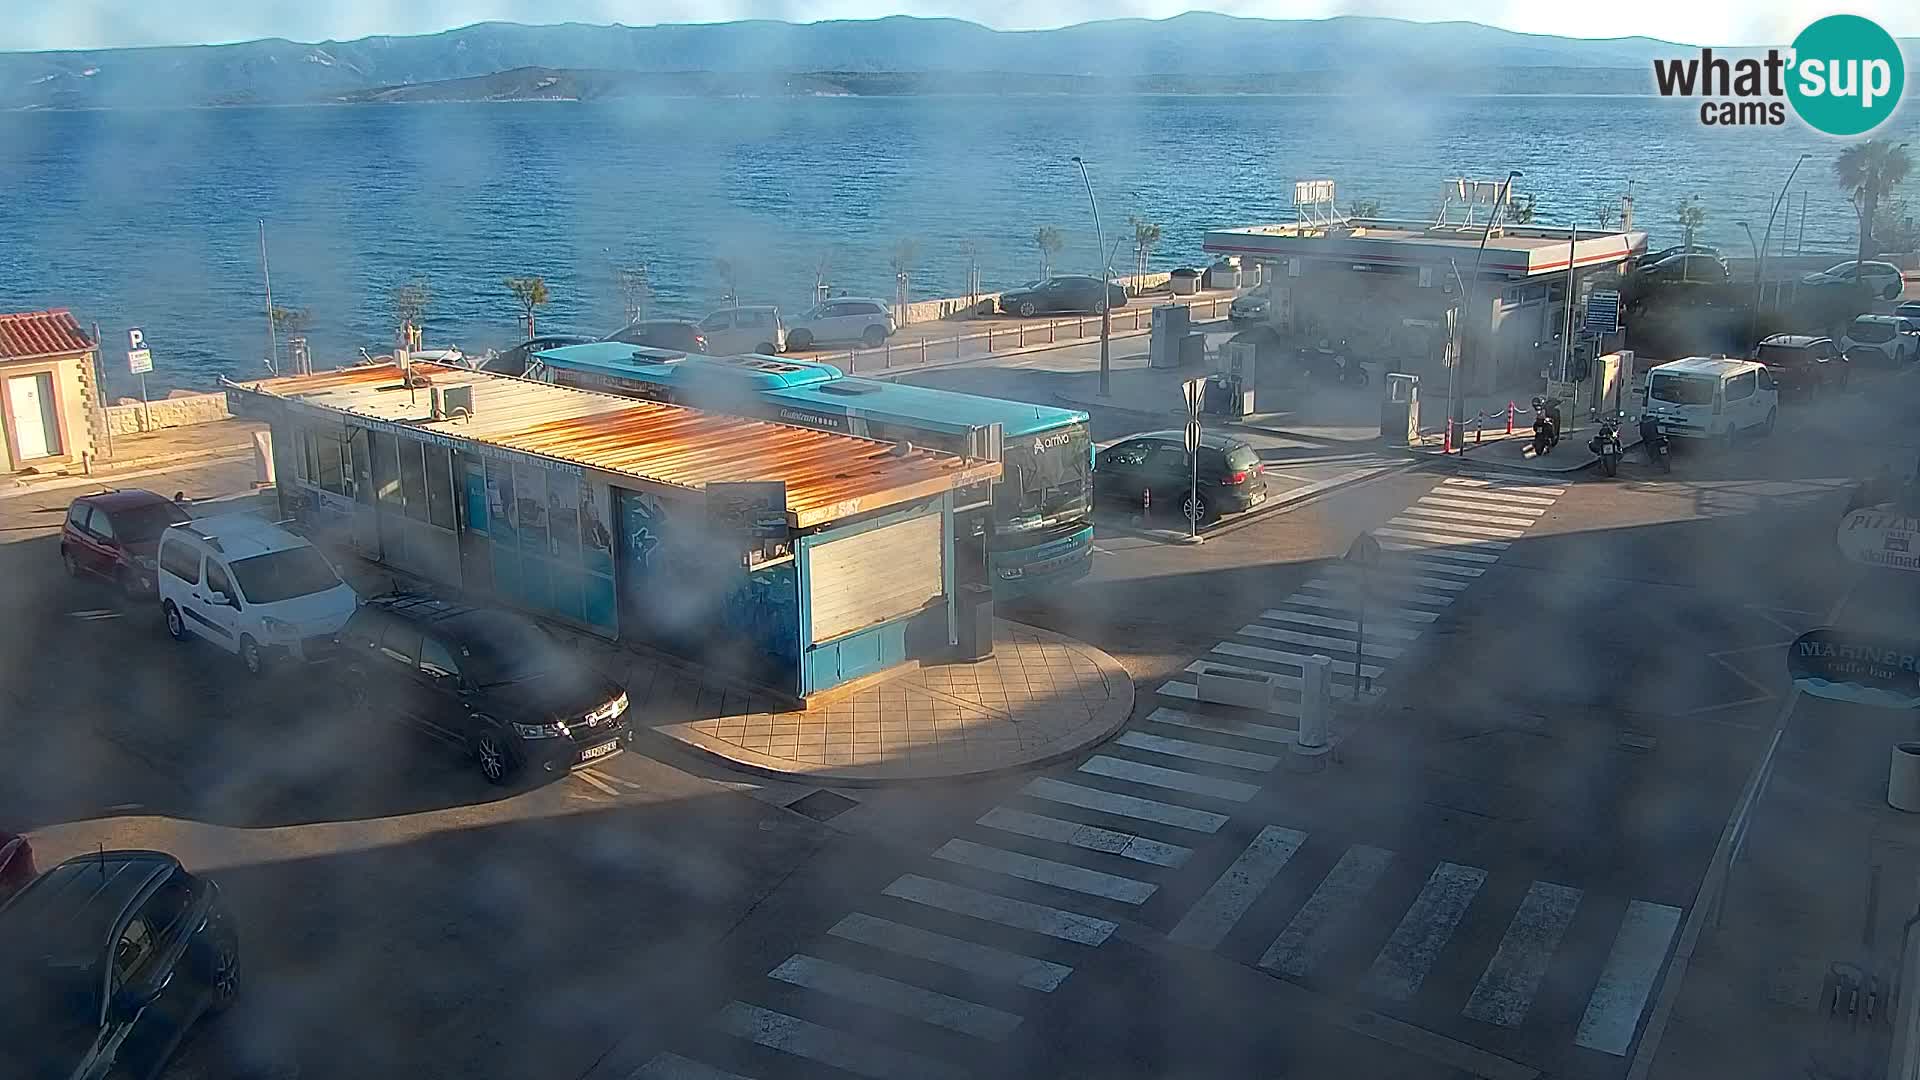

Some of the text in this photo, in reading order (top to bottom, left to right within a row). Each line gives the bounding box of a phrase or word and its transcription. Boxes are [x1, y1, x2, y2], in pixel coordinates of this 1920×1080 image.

[129, 330, 144, 349] P
[1044, 432, 1069, 448] arriva
[556, 463, 582, 476] OFFICE
